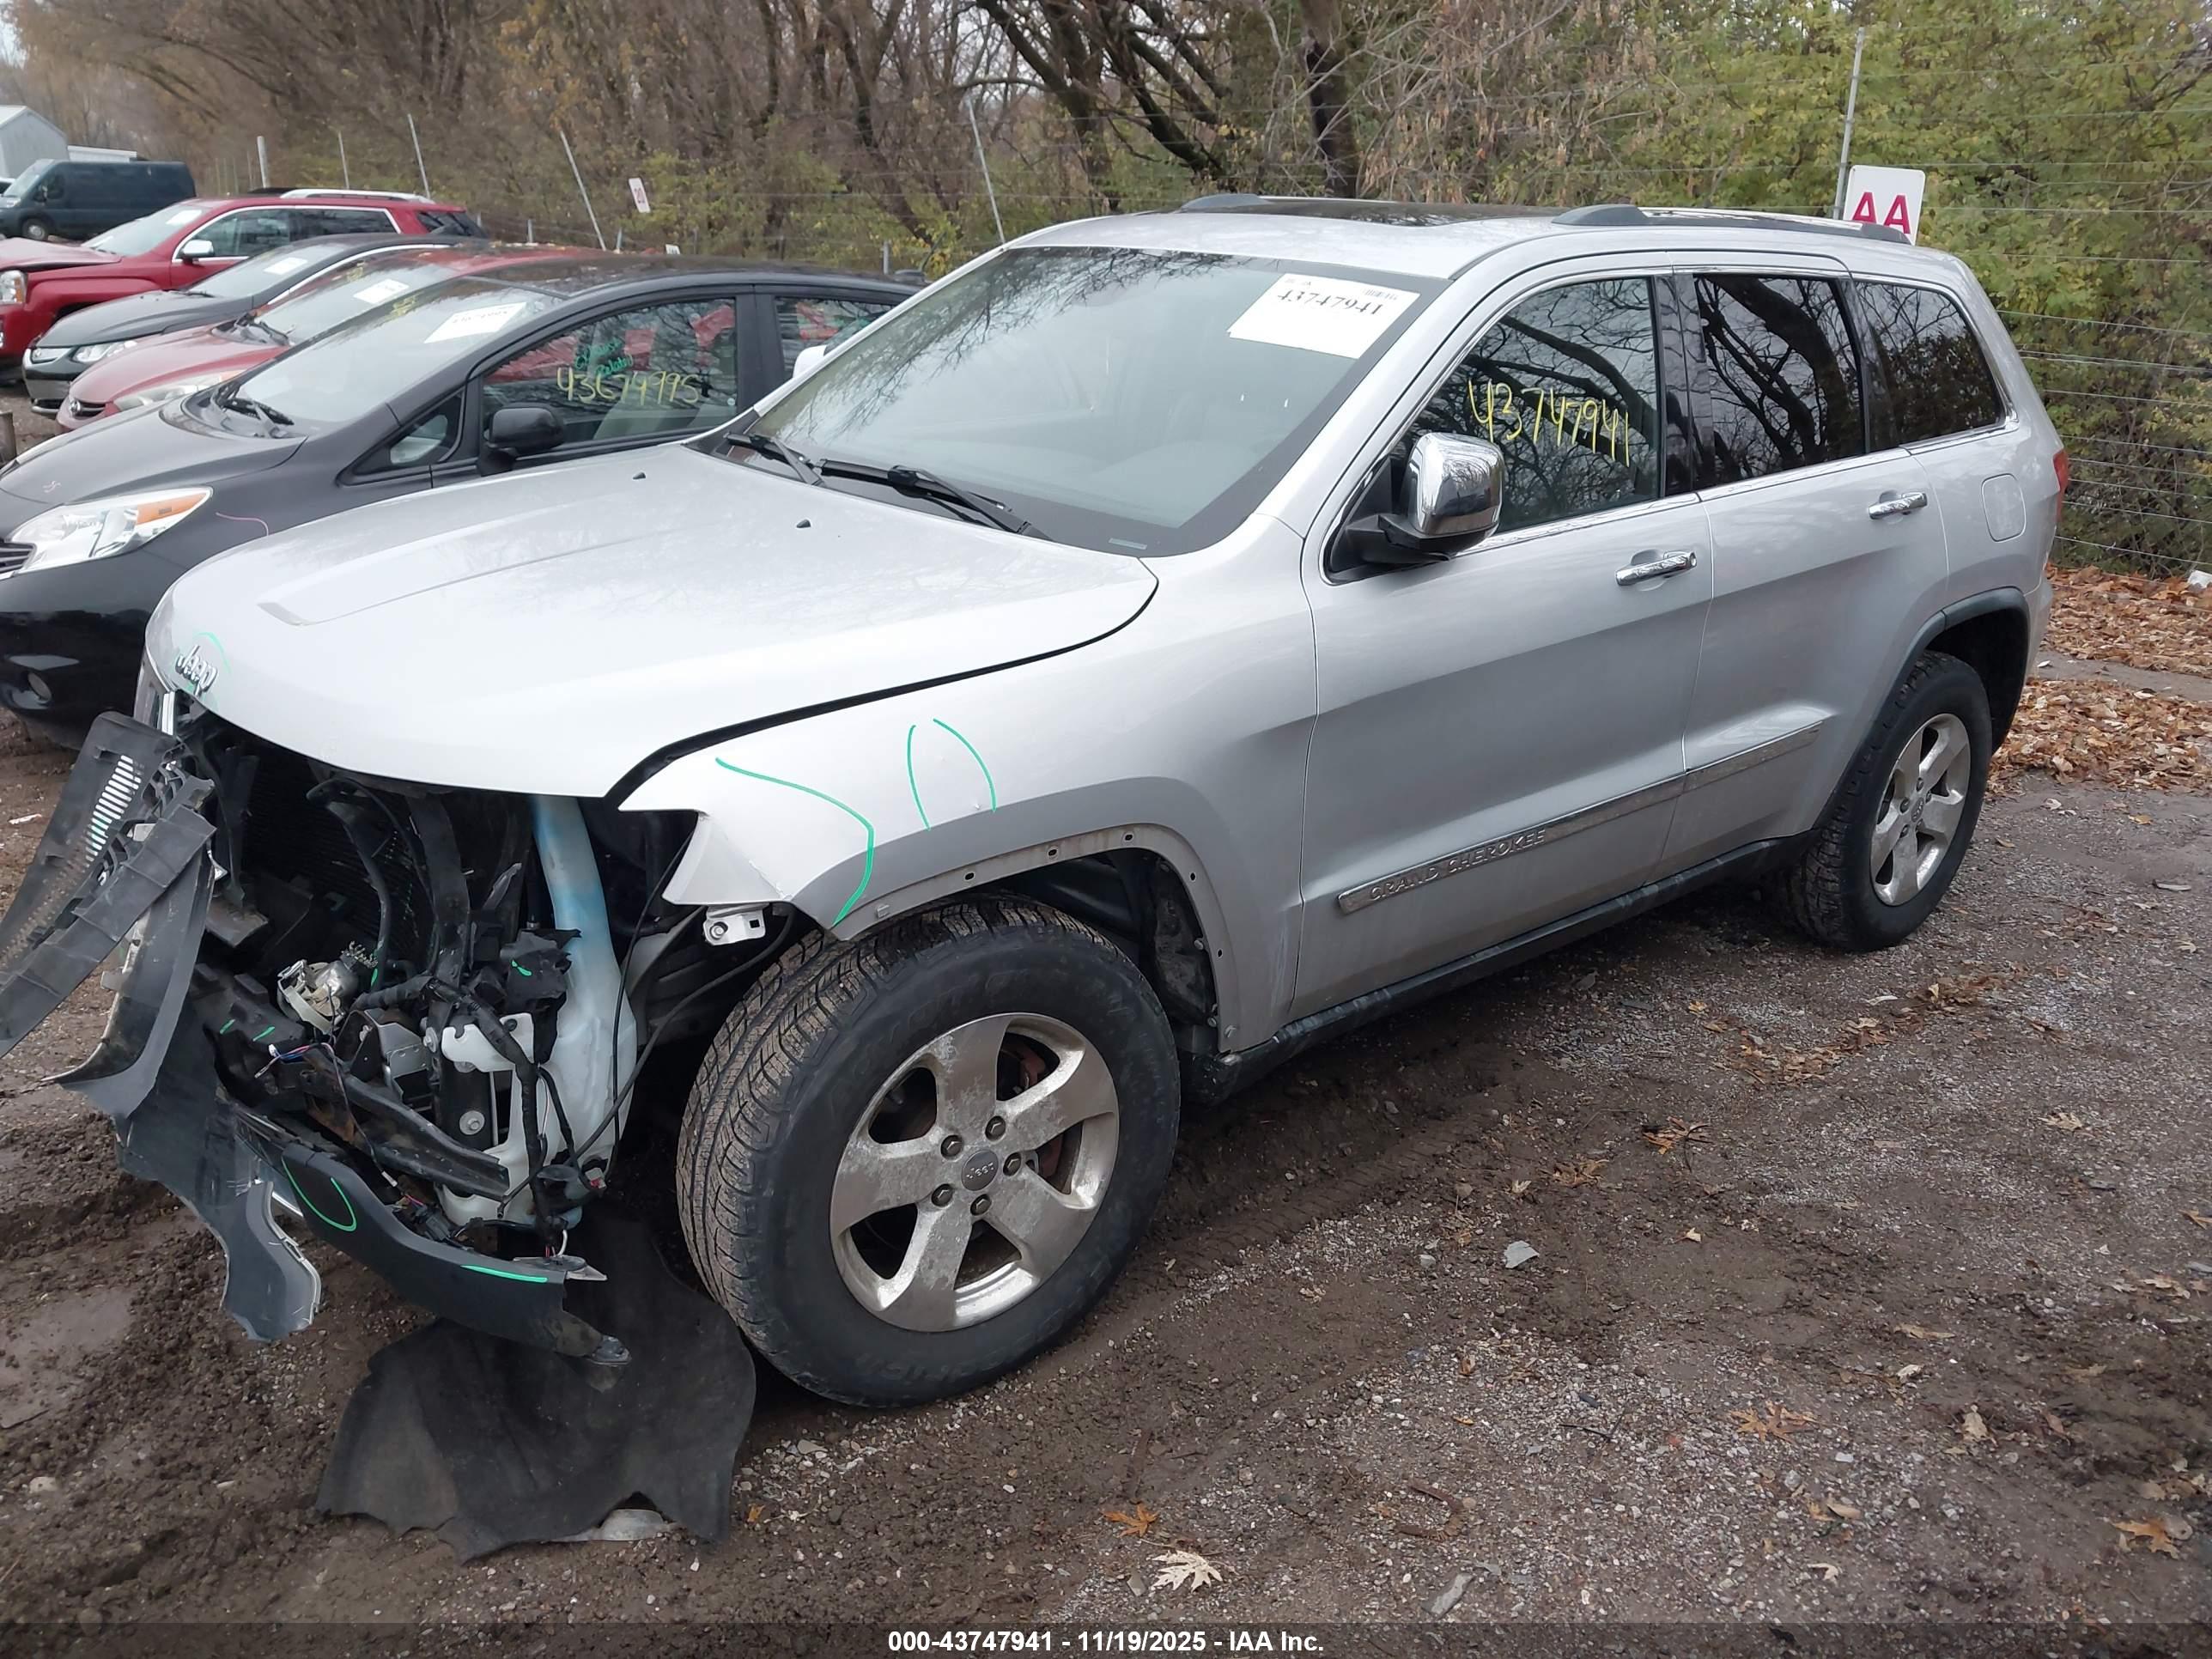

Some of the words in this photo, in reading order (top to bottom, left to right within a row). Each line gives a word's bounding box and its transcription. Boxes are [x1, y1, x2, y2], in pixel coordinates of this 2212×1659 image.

[1851, 191, 1911, 234] AA
[1277, 289, 1383, 315] 43747941
[1468, 378, 1630, 467] 43747941
[1370, 867, 1439, 901] GRAND
[1448, 830, 1546, 873] CHEROKEE
